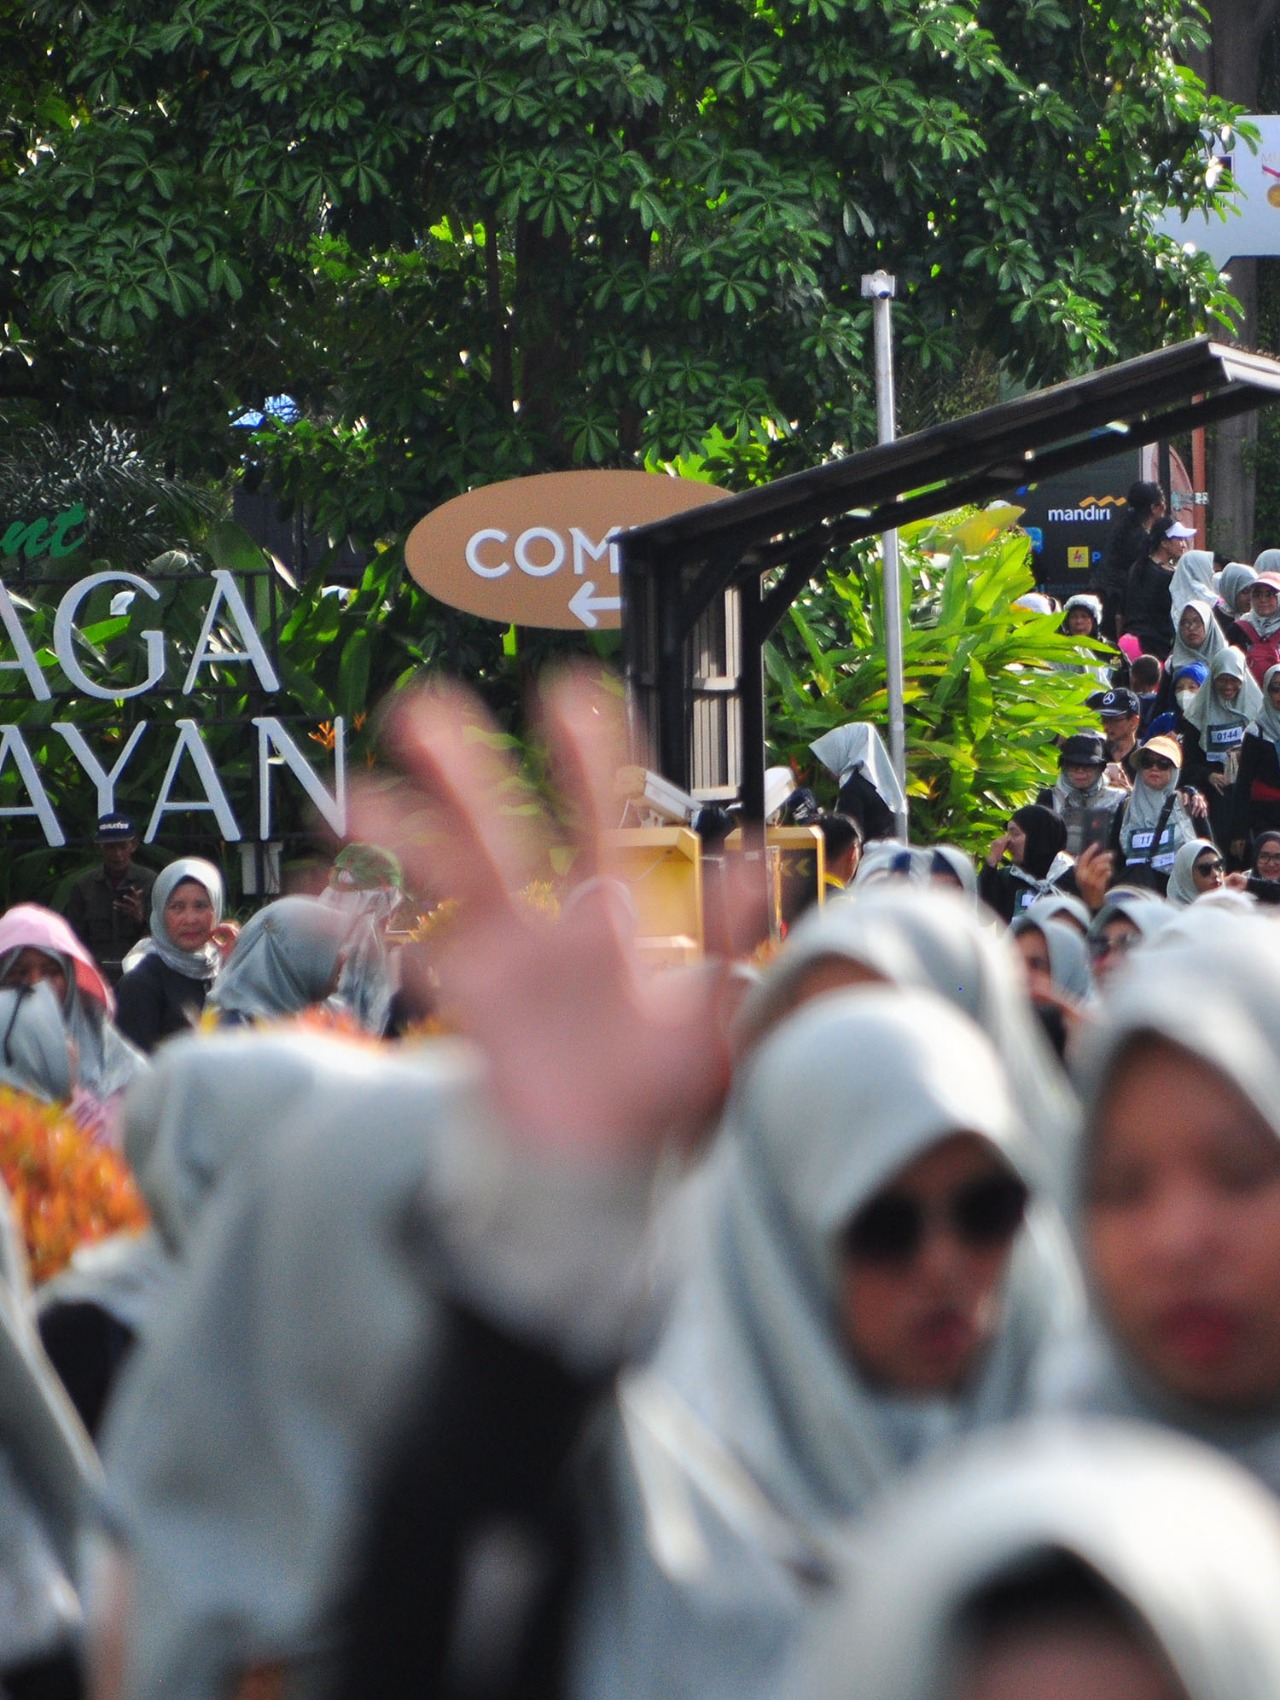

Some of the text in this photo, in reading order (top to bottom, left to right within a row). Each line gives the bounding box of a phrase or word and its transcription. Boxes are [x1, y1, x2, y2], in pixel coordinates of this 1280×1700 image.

[1048, 505, 1111, 521] mandiri
[465, 526, 639, 579] COM
[1216, 730, 1238, 741] 0144
